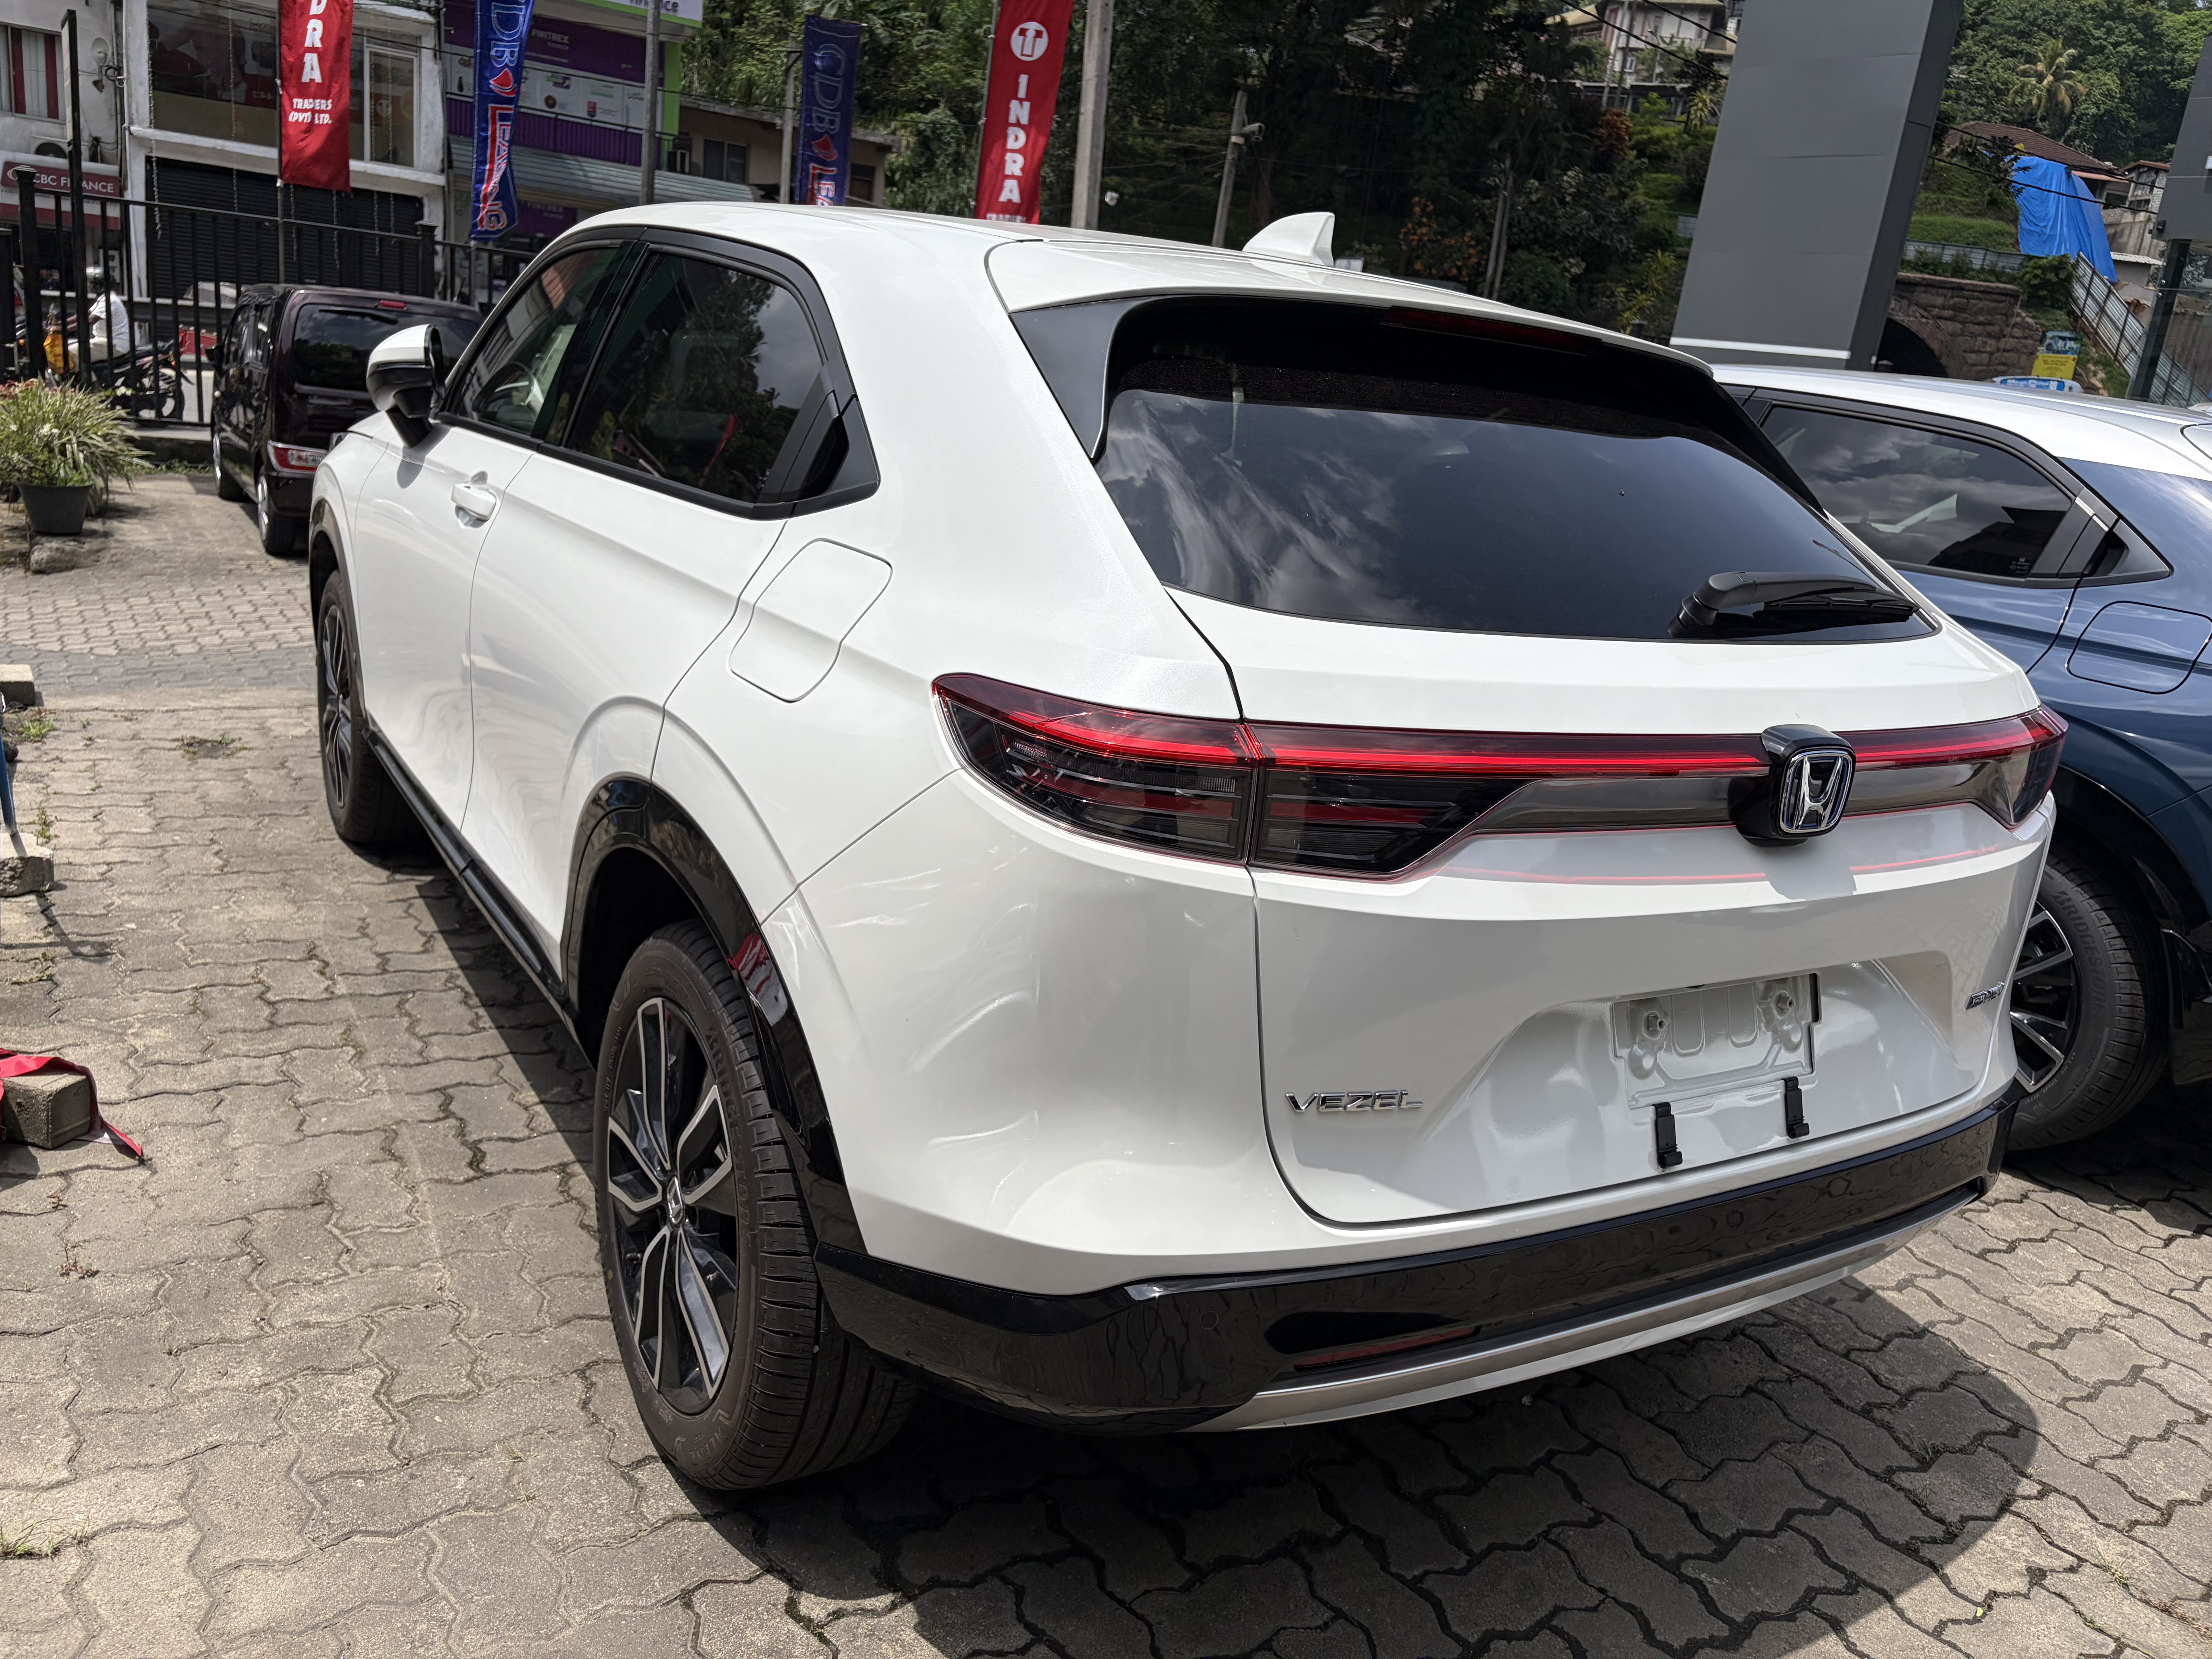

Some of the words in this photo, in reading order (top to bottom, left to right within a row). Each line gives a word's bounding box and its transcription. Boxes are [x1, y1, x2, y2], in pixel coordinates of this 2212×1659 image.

[812, 43, 846, 134] CDB
[292, 98, 332, 110] TRADERS
[998, 74, 1031, 203] INDRA
[61, 177, 114, 193] FIANCE
[1285, 1089, 1424, 1112] VEZEL
